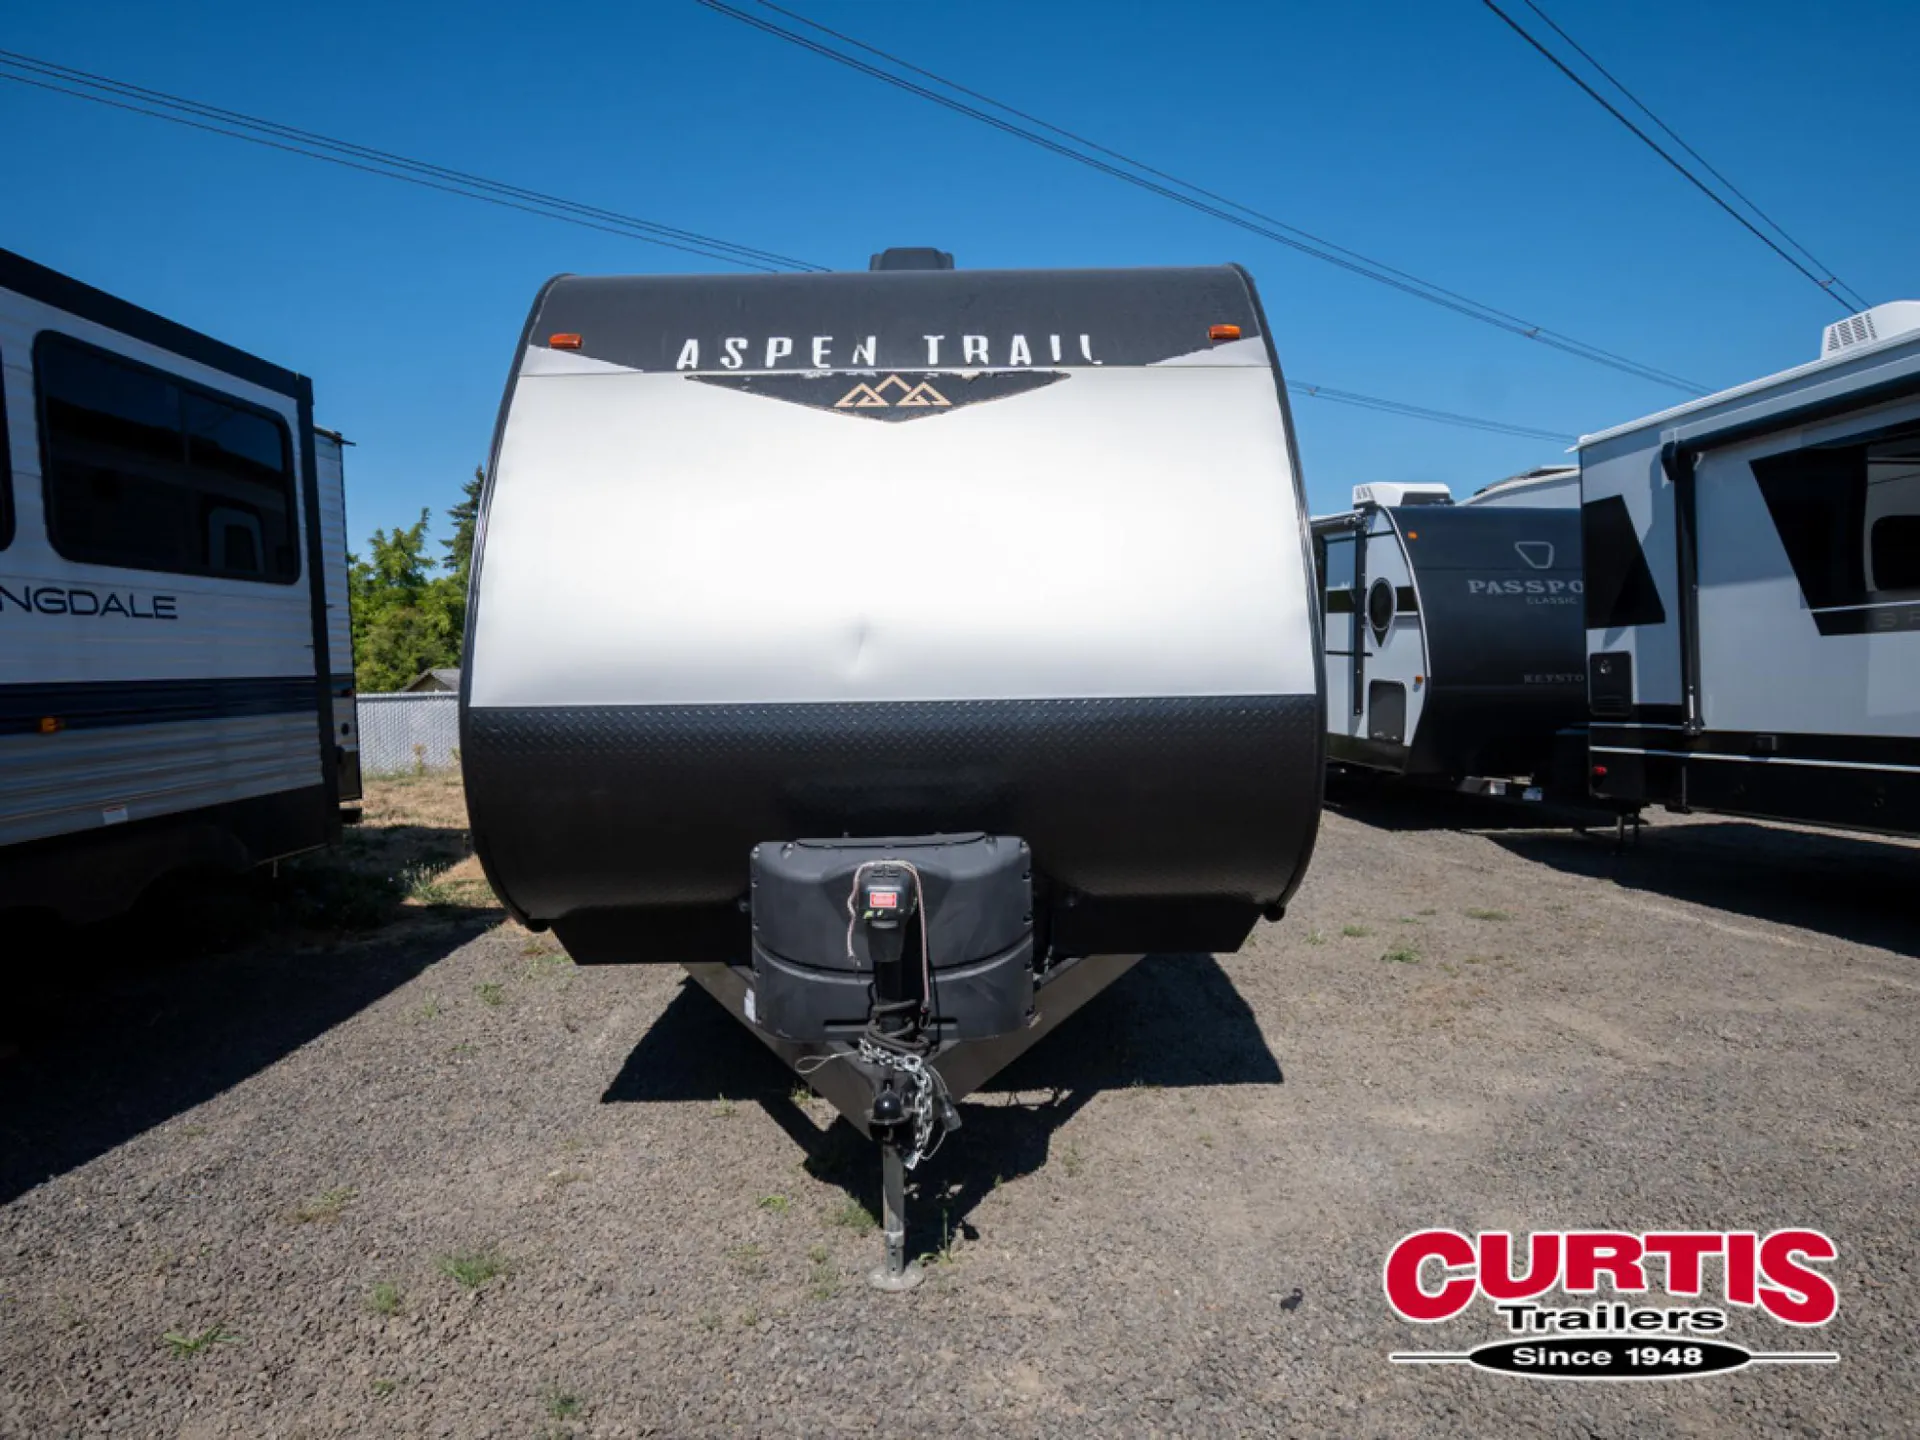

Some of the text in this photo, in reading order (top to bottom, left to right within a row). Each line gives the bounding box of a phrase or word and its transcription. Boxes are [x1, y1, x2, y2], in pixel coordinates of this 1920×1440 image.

[676, 334, 1103, 370] ASPEN TRAIL
[0, 585, 178, 620] NGDALE
[1526, 596, 1578, 605] CLASSIC
